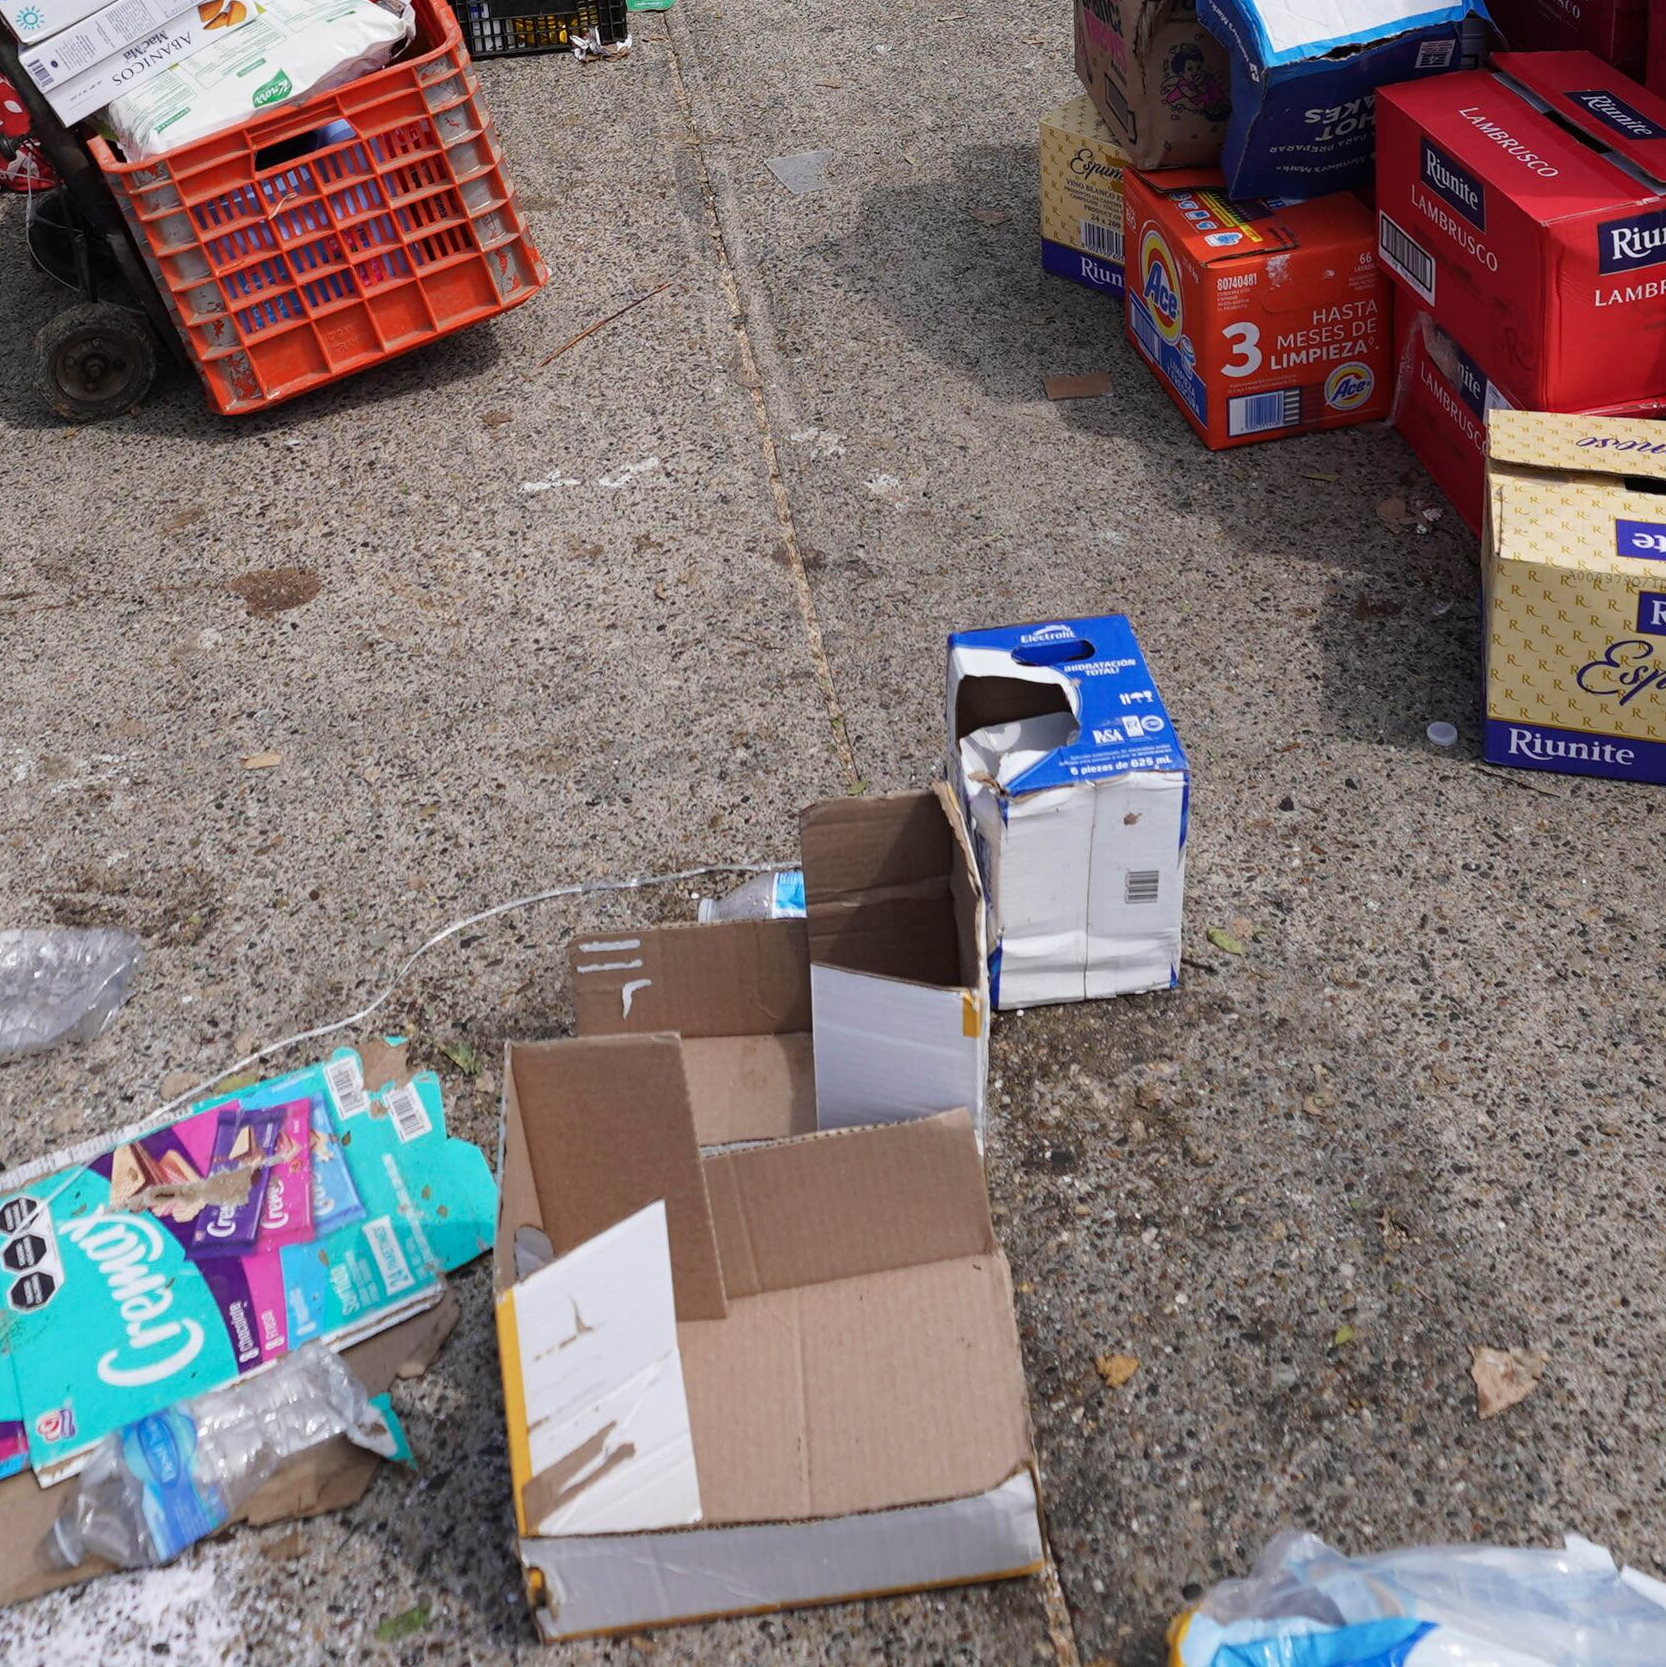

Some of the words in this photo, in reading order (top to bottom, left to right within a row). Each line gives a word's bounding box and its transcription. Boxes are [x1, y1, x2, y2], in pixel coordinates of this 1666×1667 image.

[112, 31, 192, 86] ABANICOS
[1581, 92, 1654, 139] Riunite
[1268, 143, 1334, 154] PREPARAR
[1457, 106, 1560, 180] LAMBRUSCO
[1423, 145, 1482, 211] Riunite
[1410, 185, 1501, 274] LAMBRUSCO
[1143, 262, 1181, 323] Ace
[1216, 272, 1257, 290] 80740481
[1276, 322, 1344, 350] MESES
[1351, 317, 1378, 335] DE
[1312, 299, 1379, 324] HASTA
[1220, 321, 1263, 378] 3
[1021, 631, 1077, 643] Electrolit
[1064, 658, 1136, 672] ¡HIDRATACIÓN
[1081, 765, 1114, 775] piezas
[1116, 761, 1128, 770] de
[1130, 757, 1153, 767] 625
[1155, 756, 1173, 765] mL
[1507, 726, 1636, 771] Riunite
[58, 1203, 205, 1388] Cremax
